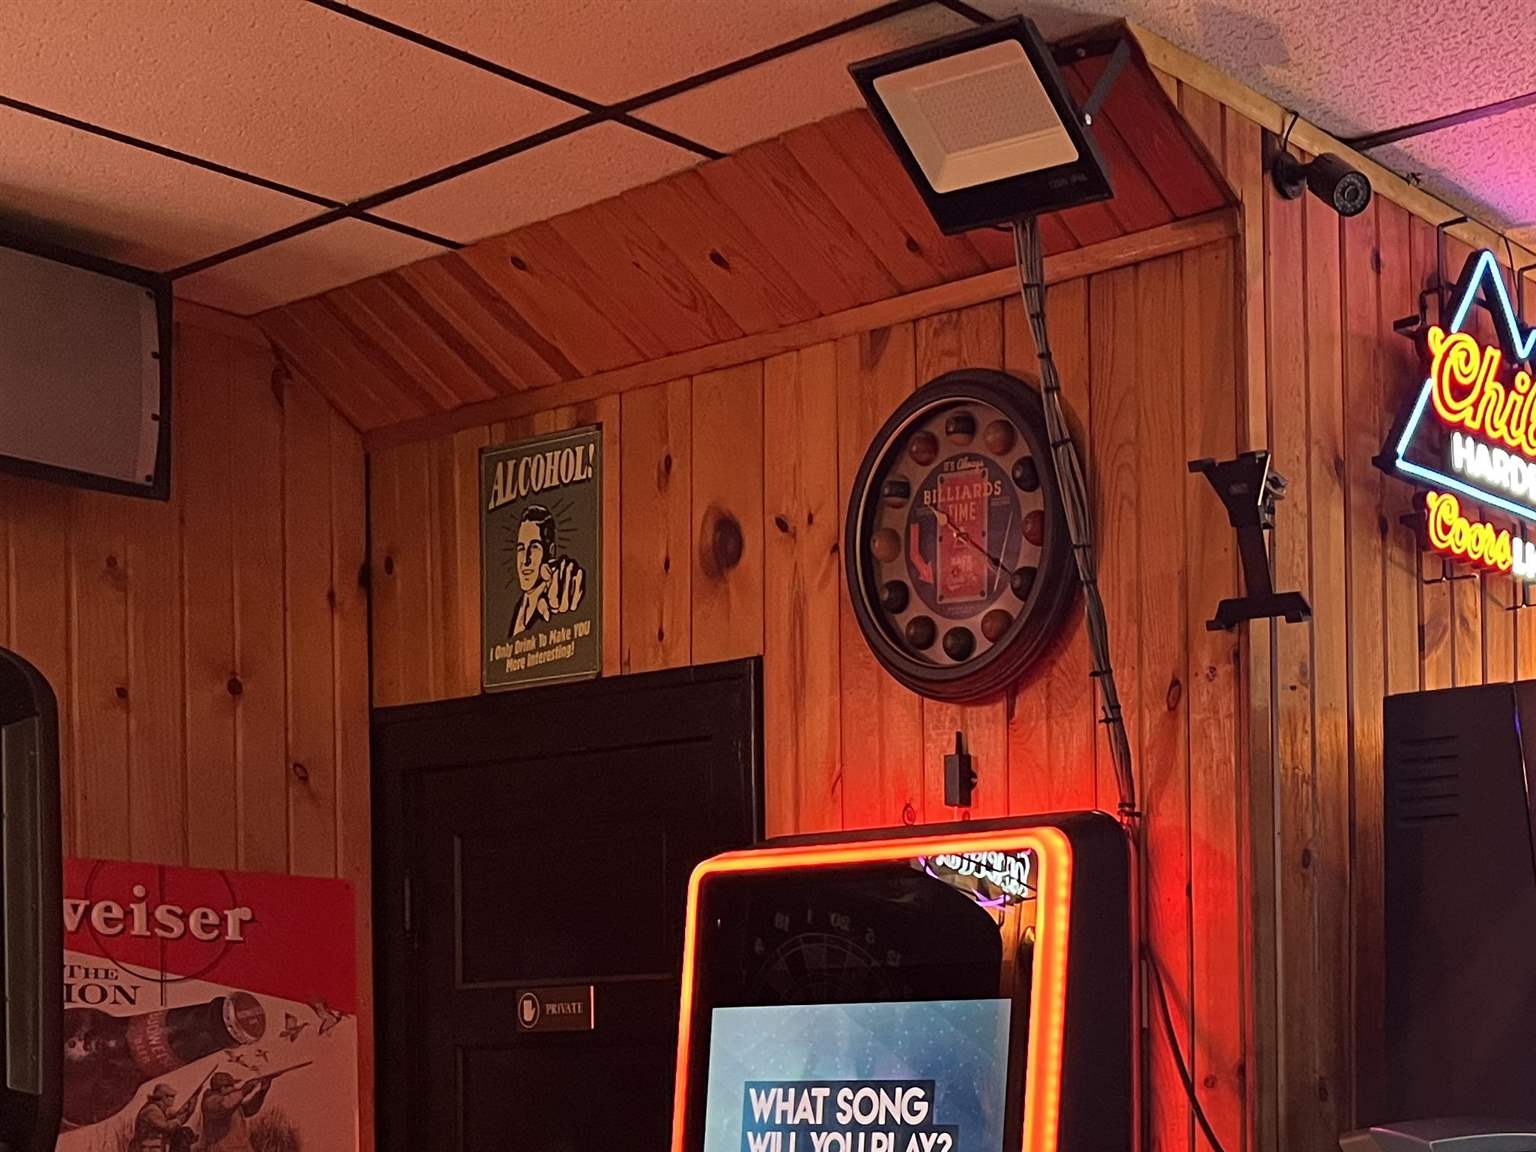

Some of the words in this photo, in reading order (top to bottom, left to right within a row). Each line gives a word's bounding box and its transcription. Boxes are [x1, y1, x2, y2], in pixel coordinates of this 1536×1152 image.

[488, 443, 595, 511] ALCOHOL!
[923, 481, 1002, 506] BILLIARDS
[948, 502, 976, 522] TIME
[1427, 491, 1513, 570] Coors
[494, 643, 514, 661] Only
[515, 636, 537, 655] Drink
[549, 628, 571, 646] Make
[573, 620, 591, 638] YOU
[505, 656, 526, 673] More
[64, 982, 142, 1006] ION
[545, 1002, 584, 1015] PRIVATE
[748, 1086, 824, 1125] WHAT
[836, 1087, 929, 1126] SONG
